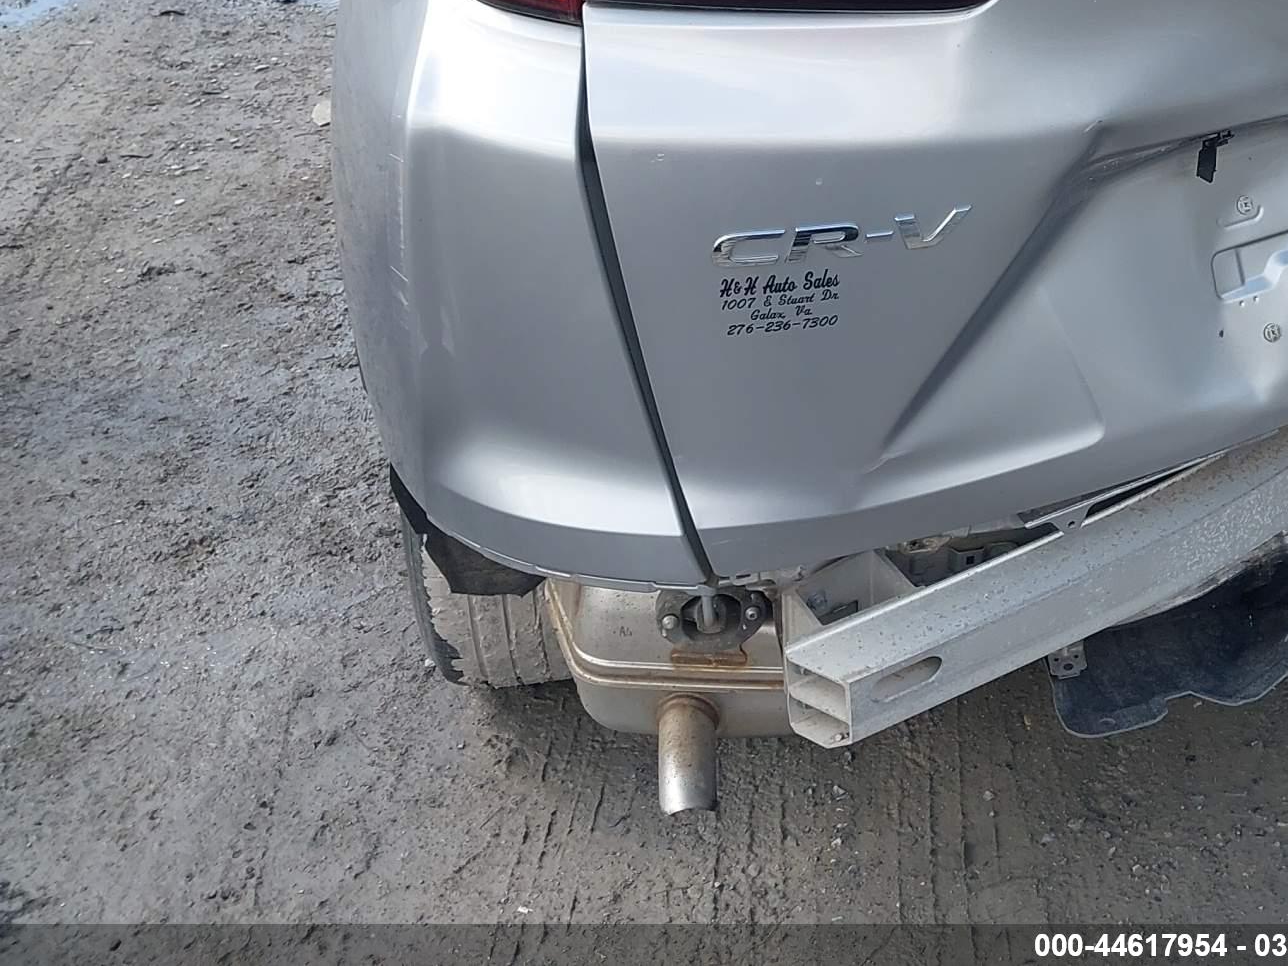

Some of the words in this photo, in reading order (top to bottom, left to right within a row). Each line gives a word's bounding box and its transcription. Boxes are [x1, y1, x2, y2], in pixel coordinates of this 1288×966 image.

[711, 203, 972, 267] CR-V
[762, 274, 798, 295] Auto
[803, 269, 840, 290] Sales
[721, 298, 756, 310] 1007
[778, 293, 816, 306] Stuart
[727, 314, 839, 336] 276-236-7300
